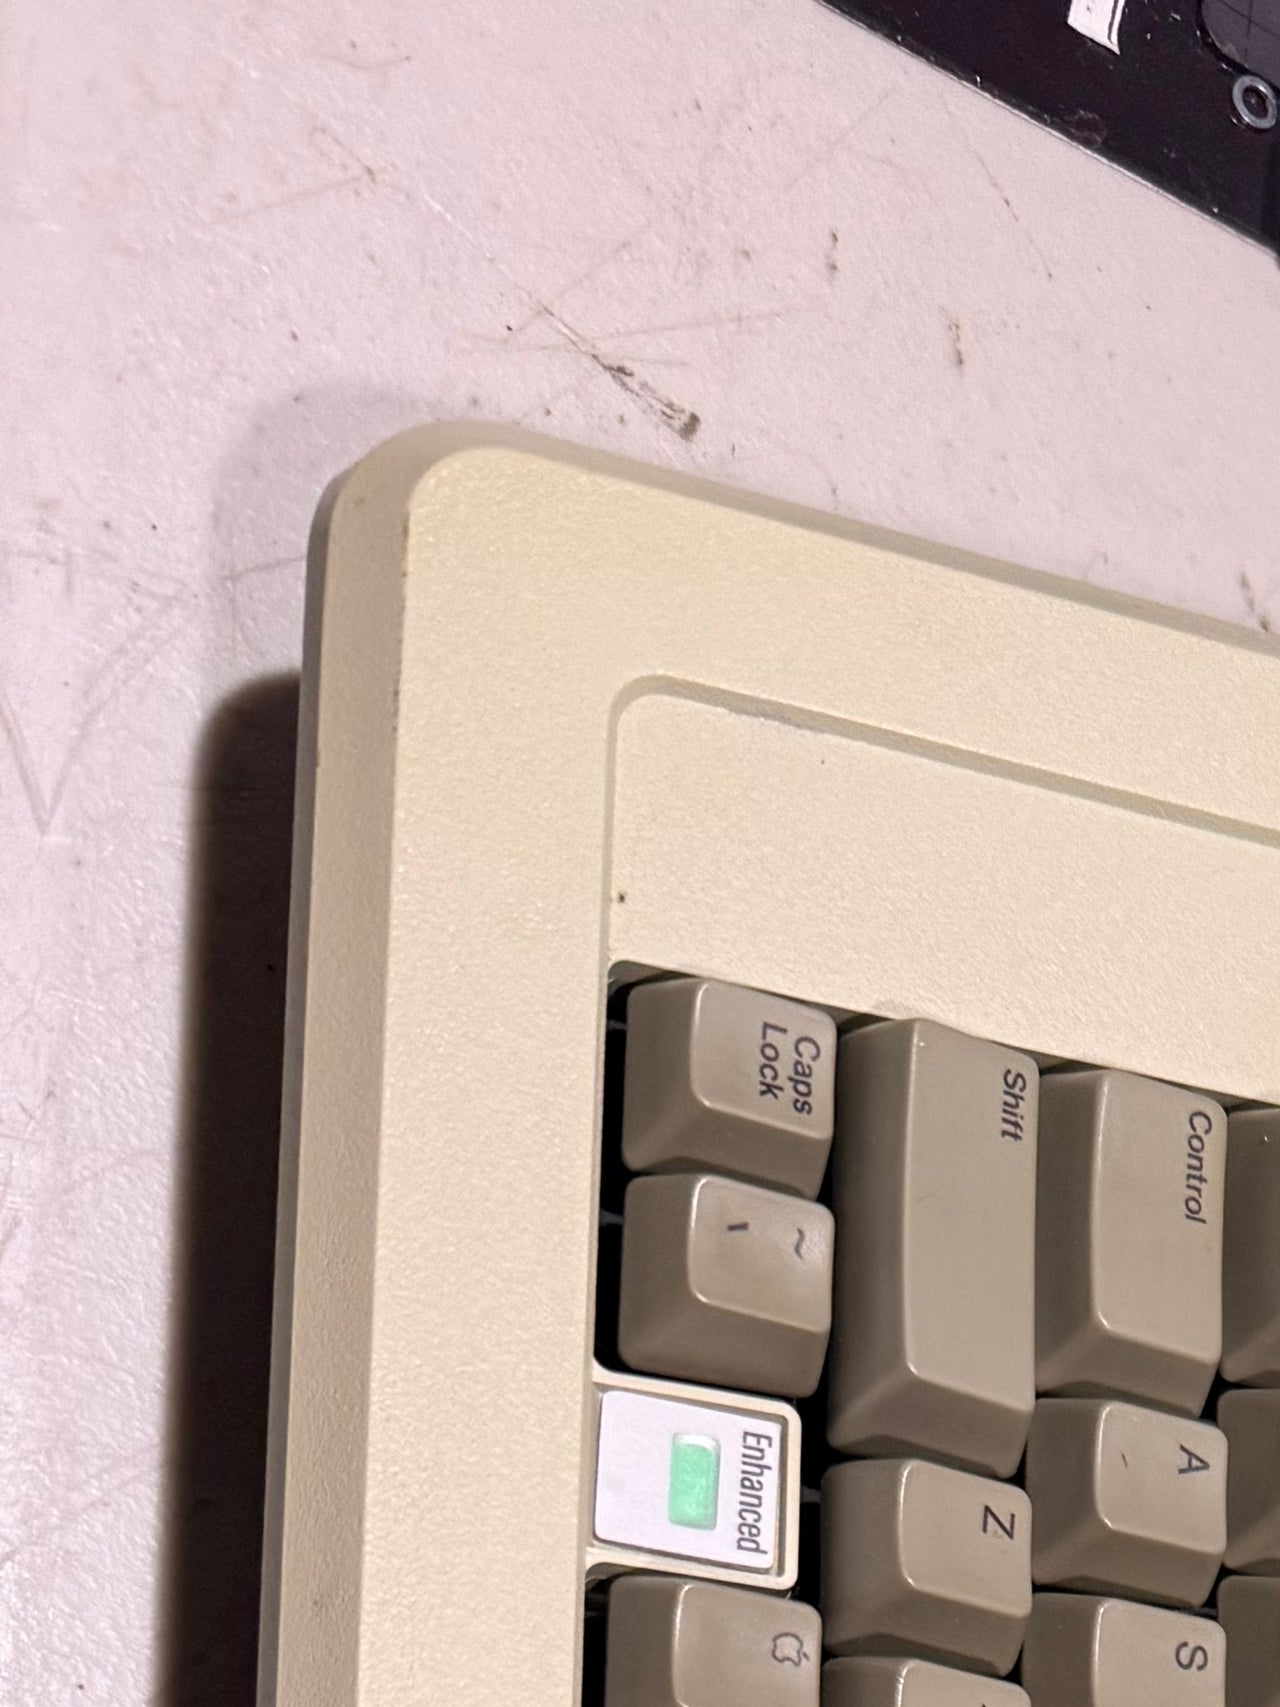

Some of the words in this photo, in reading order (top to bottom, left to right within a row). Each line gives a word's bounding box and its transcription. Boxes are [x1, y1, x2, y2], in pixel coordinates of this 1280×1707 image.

[759, 1022, 787, 1099] Lock
[787, 1036, 821, 1115] Caps
[1001, 1069, 1026, 1141] Shift
[1185, 1111, 1212, 1224] Control
[737, 1431, 772, 1554] Enhanced
[1178, 1444, 1210, 1474] A
[982, 1505, 1015, 1539] Z
[1175, 1642, 1208, 1671] S
